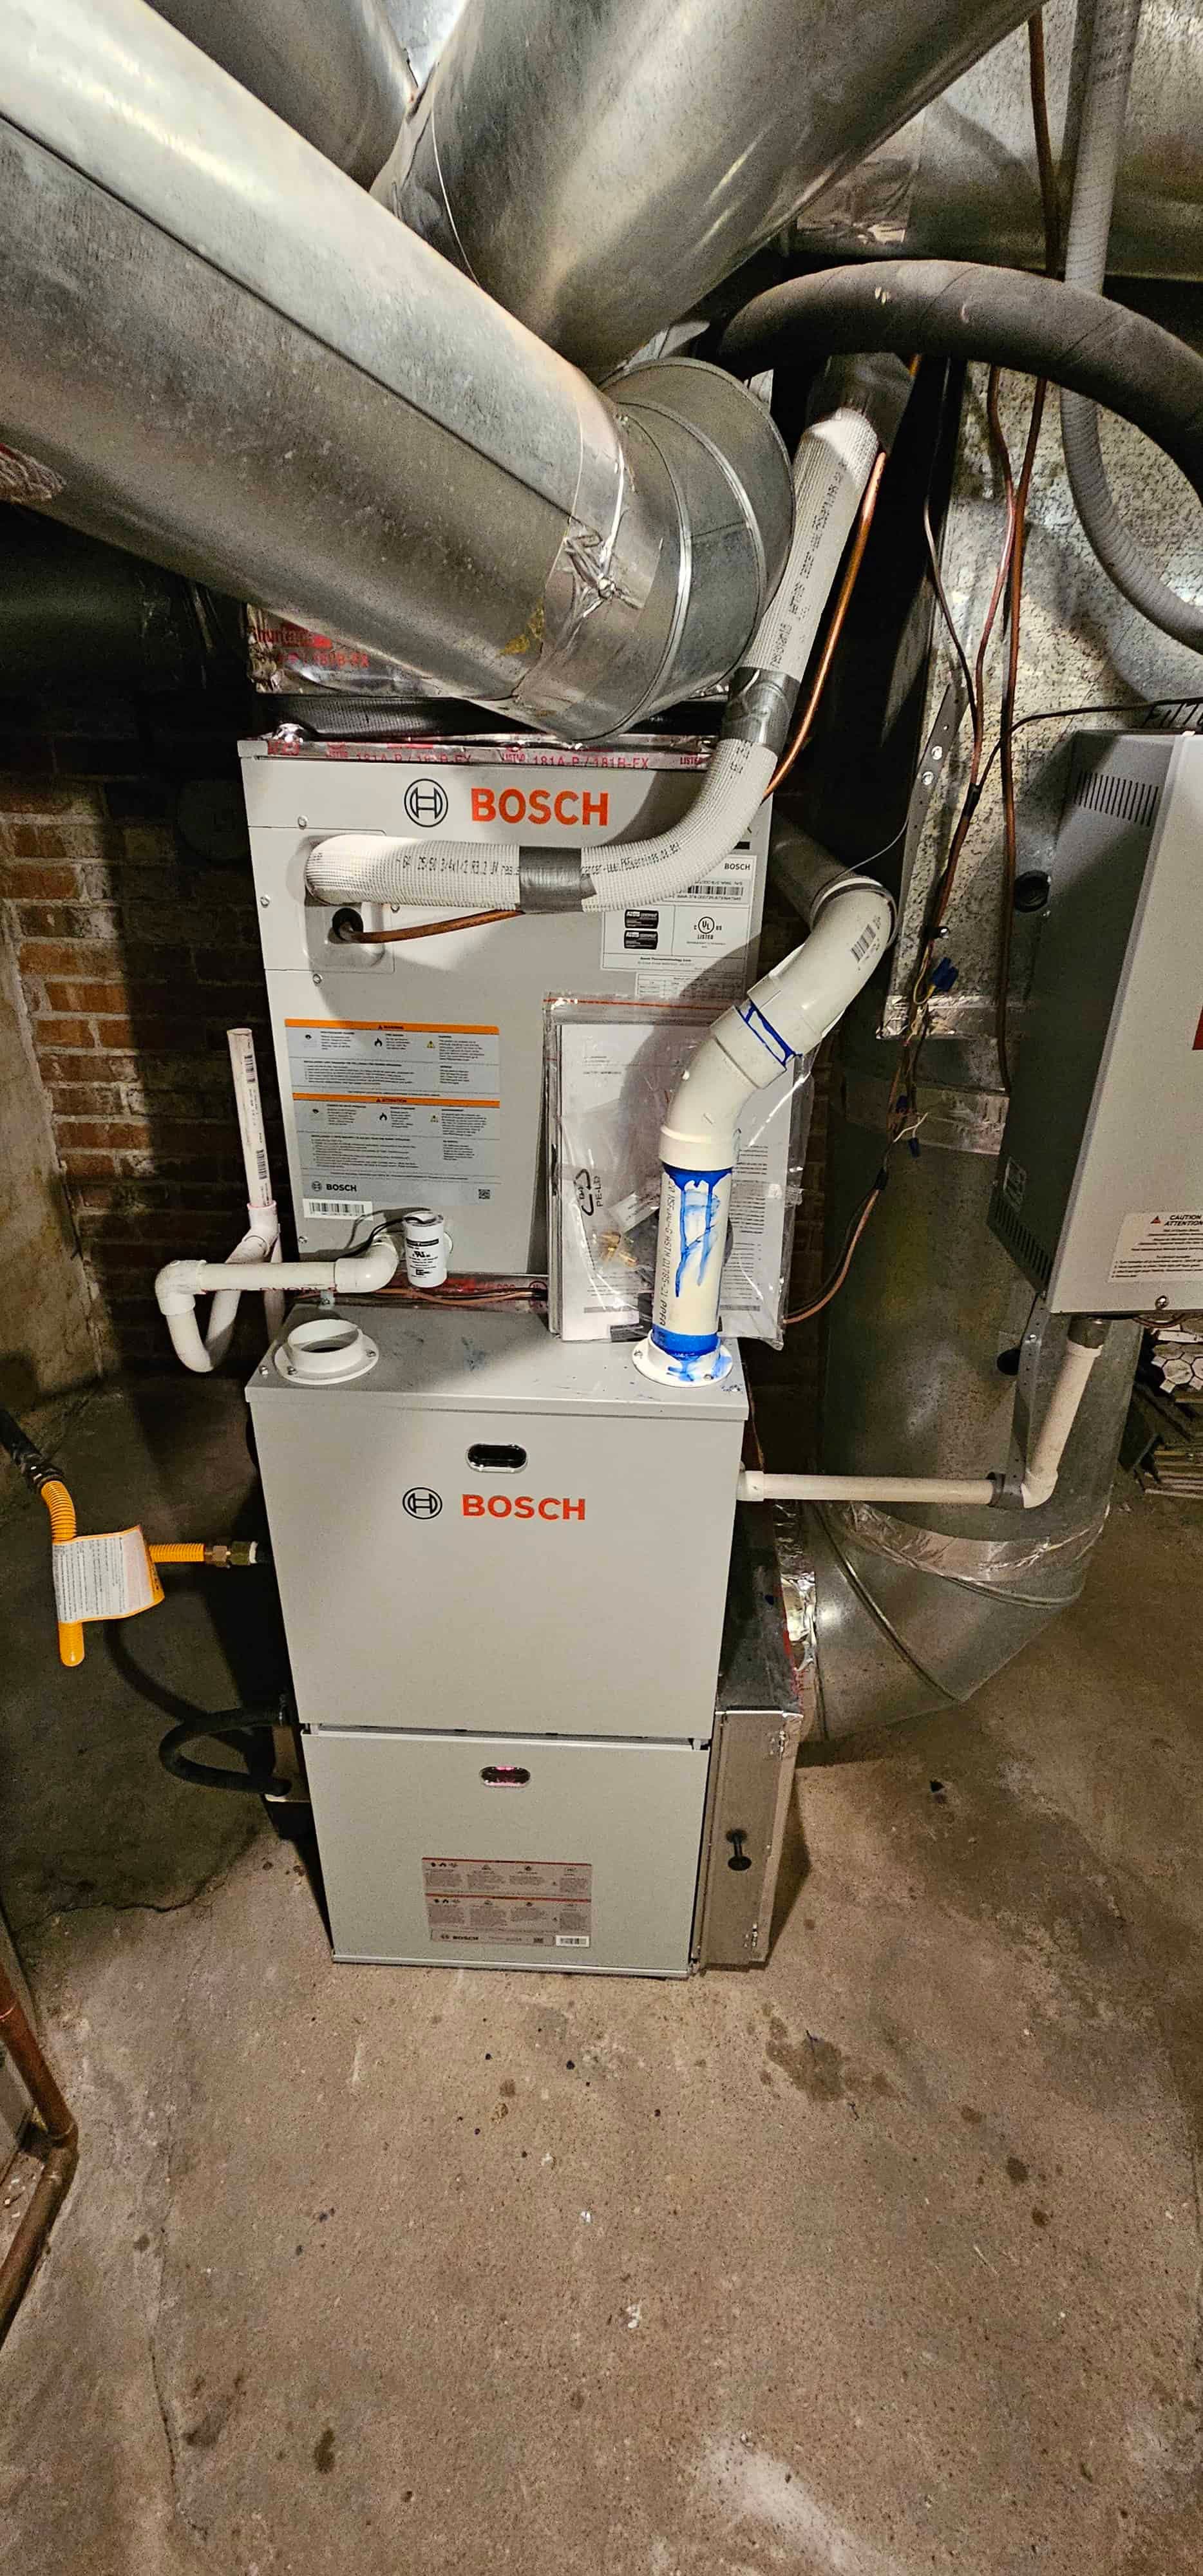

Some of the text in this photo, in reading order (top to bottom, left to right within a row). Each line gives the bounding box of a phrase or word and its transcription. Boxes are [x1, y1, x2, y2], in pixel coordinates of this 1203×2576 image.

[471, 788, 608, 826] BOSCH
[326, 1183, 357, 1192] BOSCH
[594, 1176, 603, 1207] PE-LD
[462, 1493, 585, 1520] BOSCH
